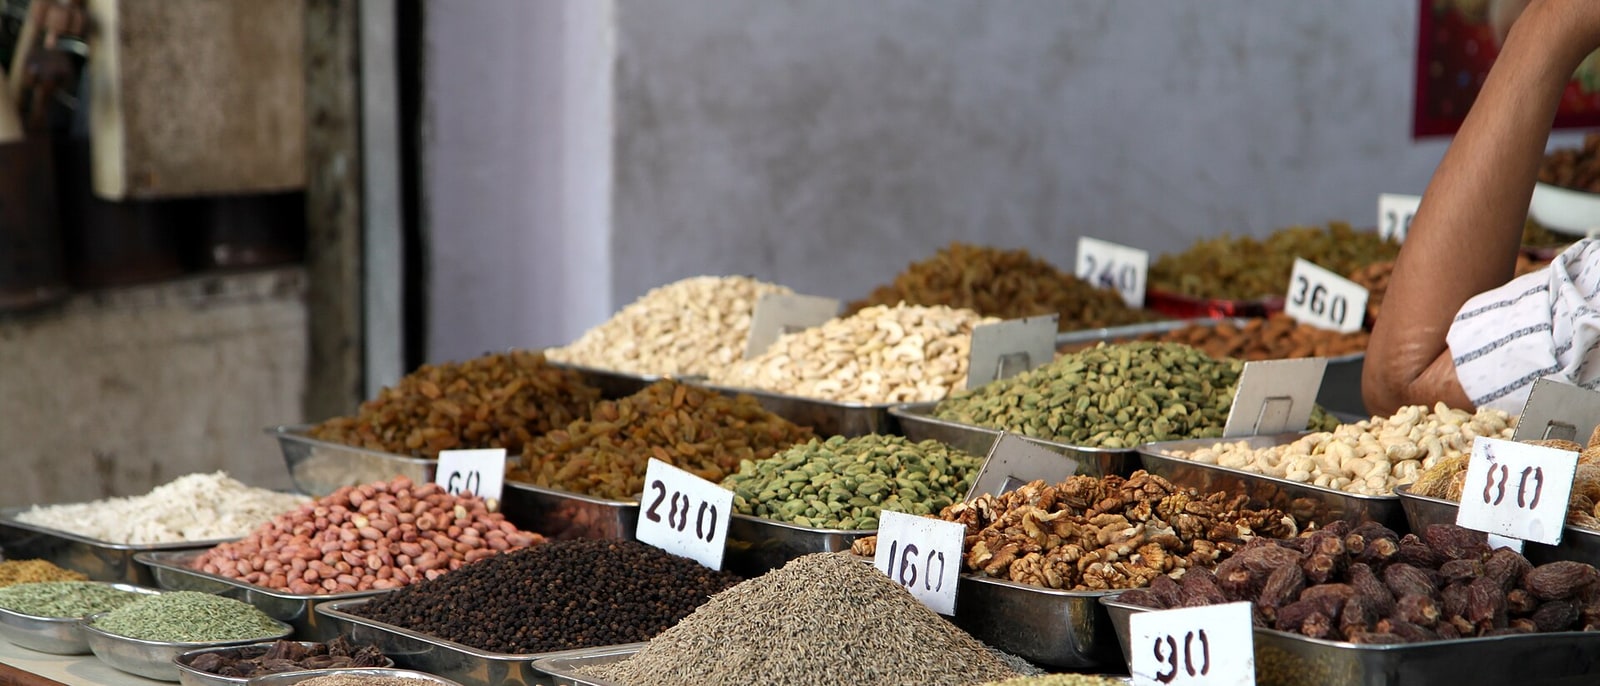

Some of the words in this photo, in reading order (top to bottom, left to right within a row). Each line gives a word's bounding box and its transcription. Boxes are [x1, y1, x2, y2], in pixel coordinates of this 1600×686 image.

[1293, 275, 1347, 325] 360
[447, 470, 481, 497] 60
[1483, 462, 1544, 510] 80
[646, 479, 718, 543] 280
[887, 539, 945, 592] 160
[1153, 628, 1210, 684] 90
